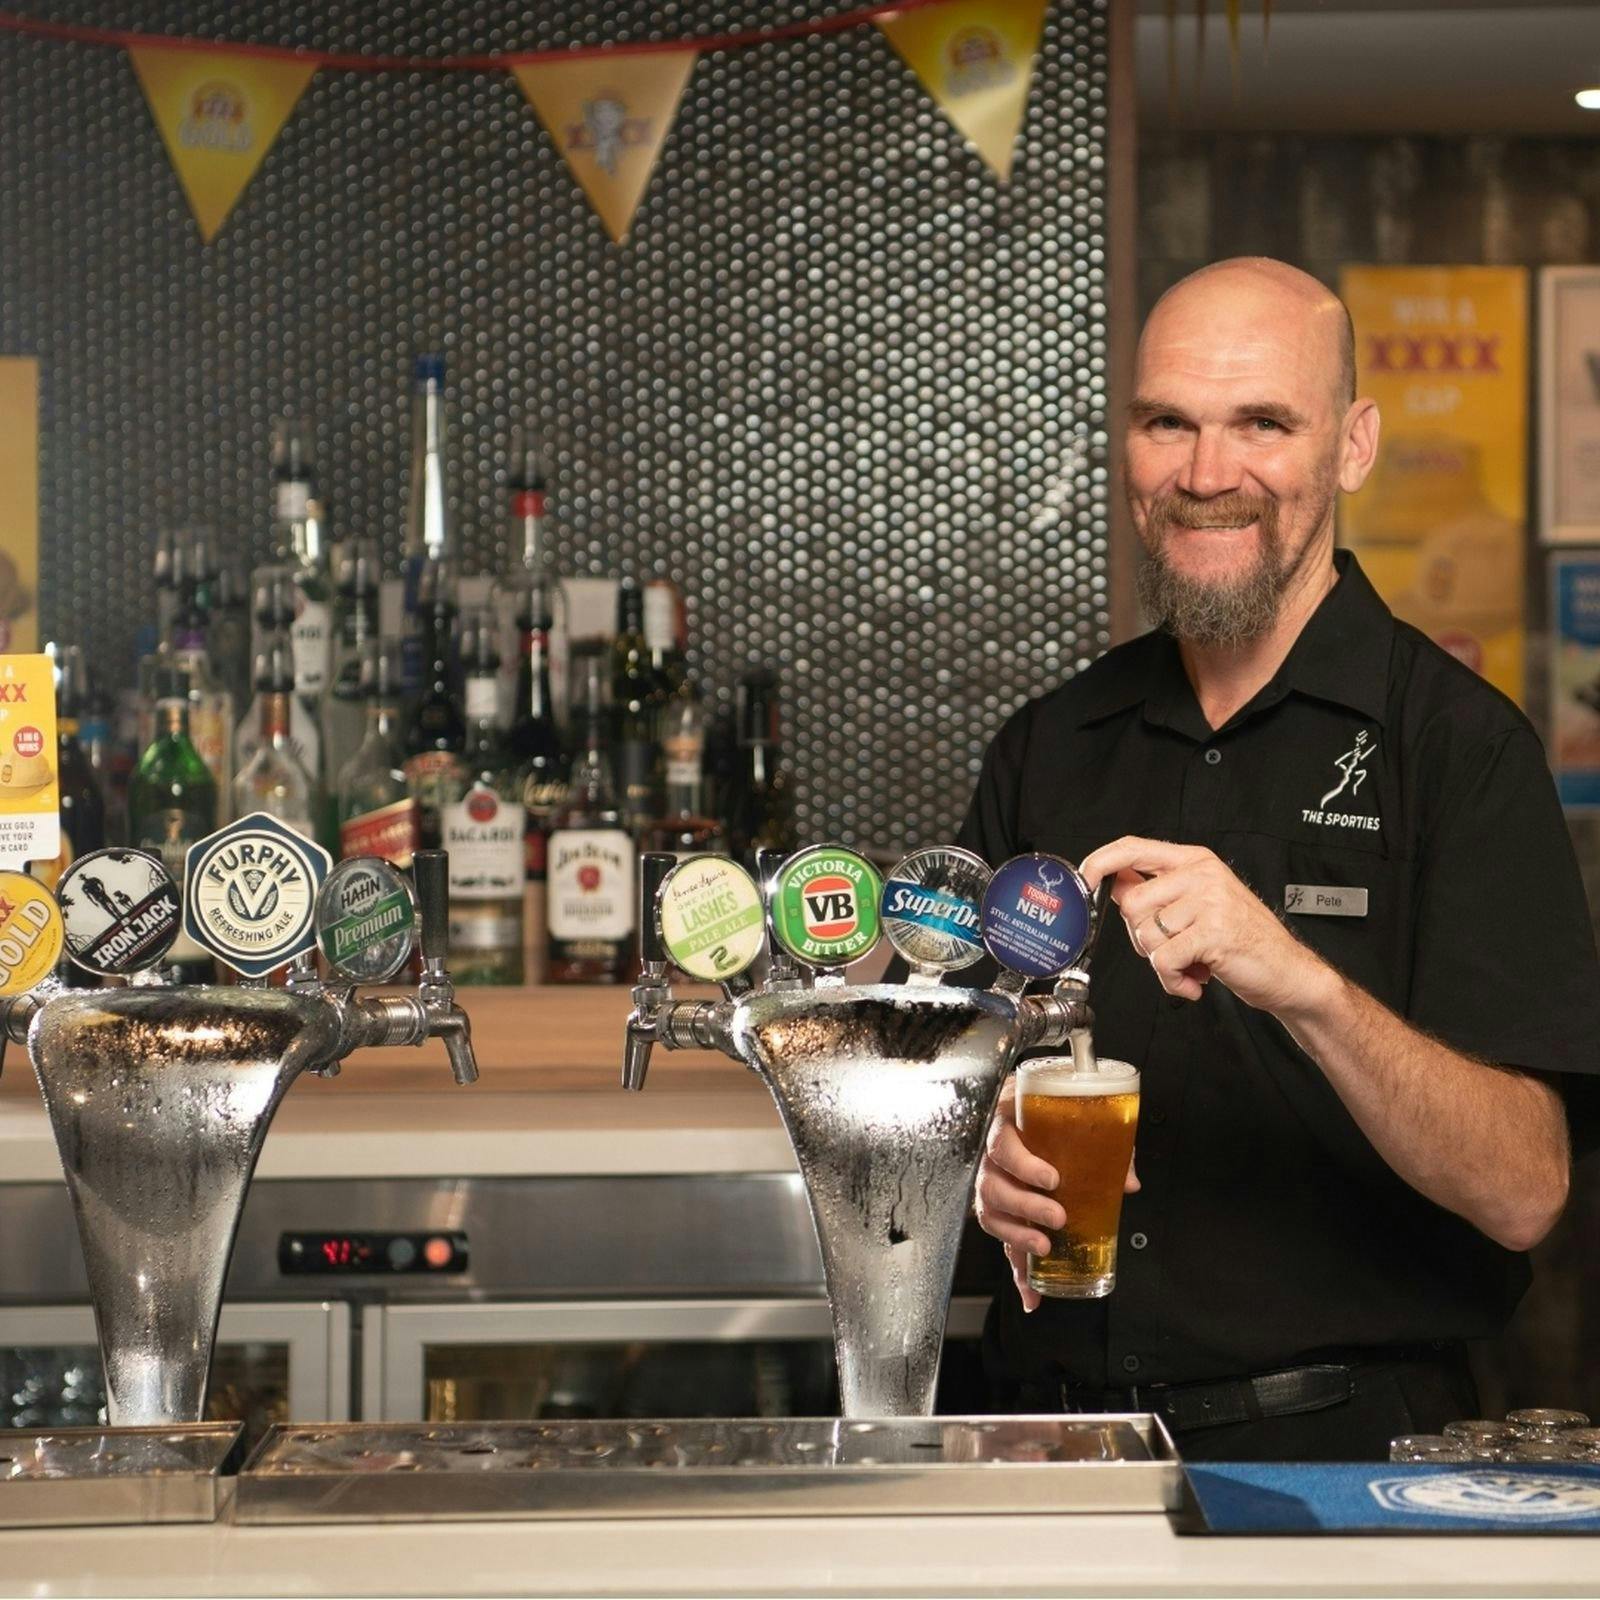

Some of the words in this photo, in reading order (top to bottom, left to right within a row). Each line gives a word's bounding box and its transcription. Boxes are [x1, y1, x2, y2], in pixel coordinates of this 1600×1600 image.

[1367, 336, 1502, 374] XXXX
[0, 683, 27, 702] XX
[1302, 809, 1324, 824] THE
[1324, 812, 1381, 831] SPORTIES
[207, 844, 302, 885] FURPHY
[788, 860, 864, 888] VICTORIA
[341, 876, 380, 910] HAHN
[804, 893, 855, 923] VB
[1316, 894, 1343, 907] Pete
[210, 907, 274, 942] REFRESHING
[275, 911, 294, 934] ALE
[681, 890, 739, 934] LASHES
[888, 888, 983, 938] SuperDr
[1016, 897, 1057, 927] NEW
[92, 926, 139, 968] IRON
[131, 895, 178, 936] JACK
[334, 905, 403, 957] Premium
[689, 927, 722, 952] PALE
[724, 914, 749, 934] ALE
[801, 931, 869, 955] BITTER
